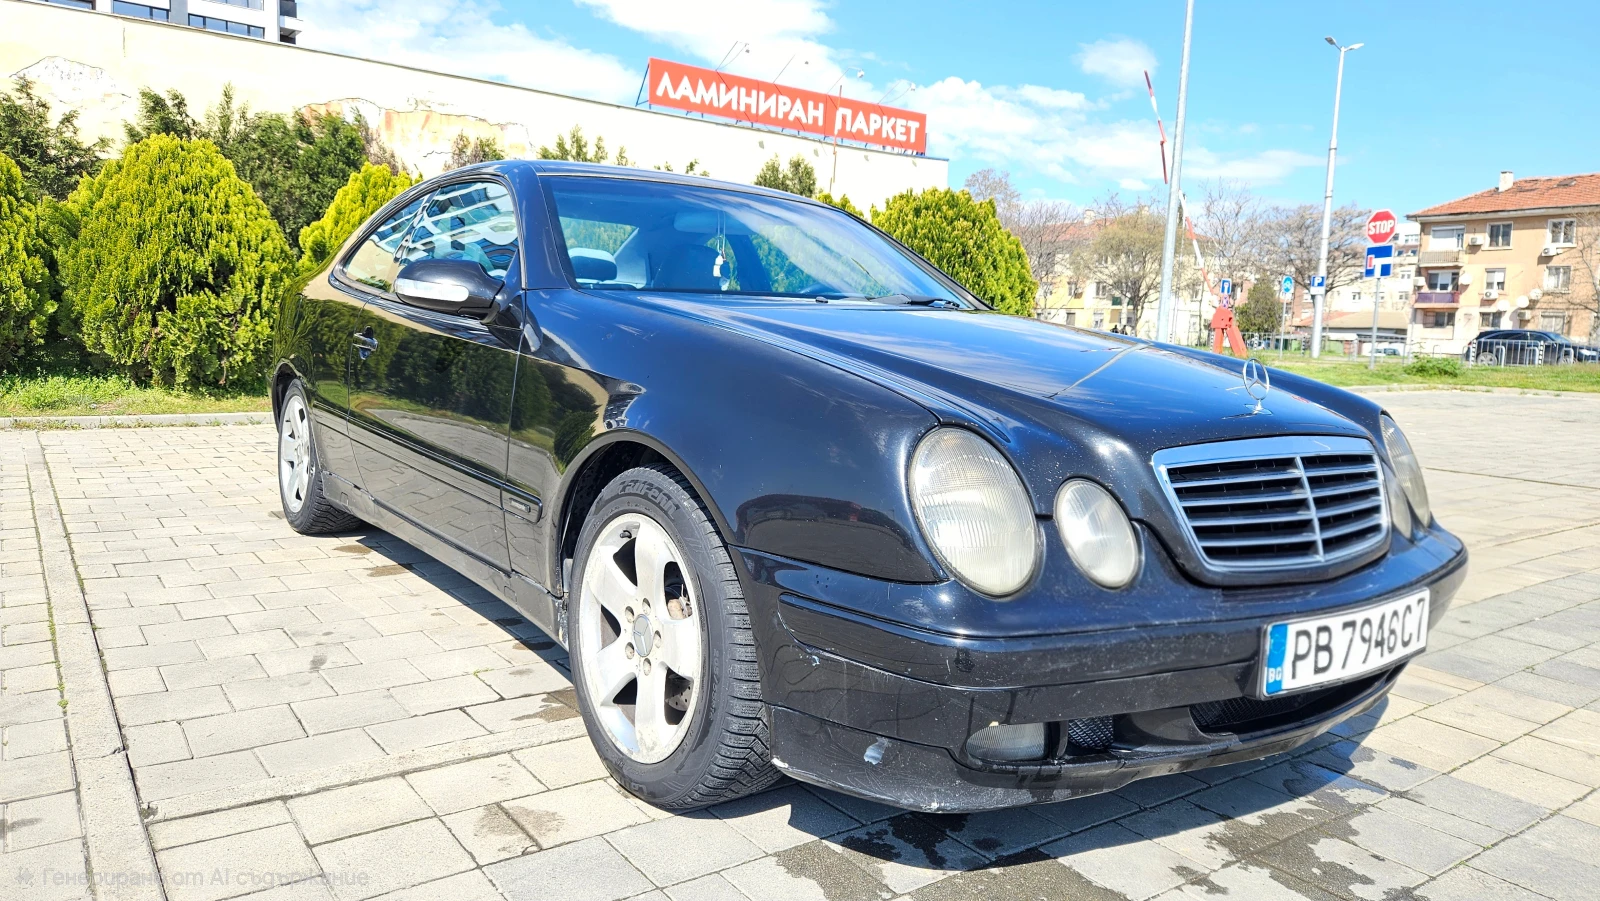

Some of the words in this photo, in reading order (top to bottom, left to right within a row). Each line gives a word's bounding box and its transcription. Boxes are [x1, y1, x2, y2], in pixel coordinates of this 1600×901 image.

[656, 71, 824, 127] ЛАМИНИРАН
[835, 107, 920, 143] ПАРКЕТ
[1368, 219, 1395, 235] STOP
[1313, 276, 1323, 287] P
[1268, 666, 1282, 684] BG
